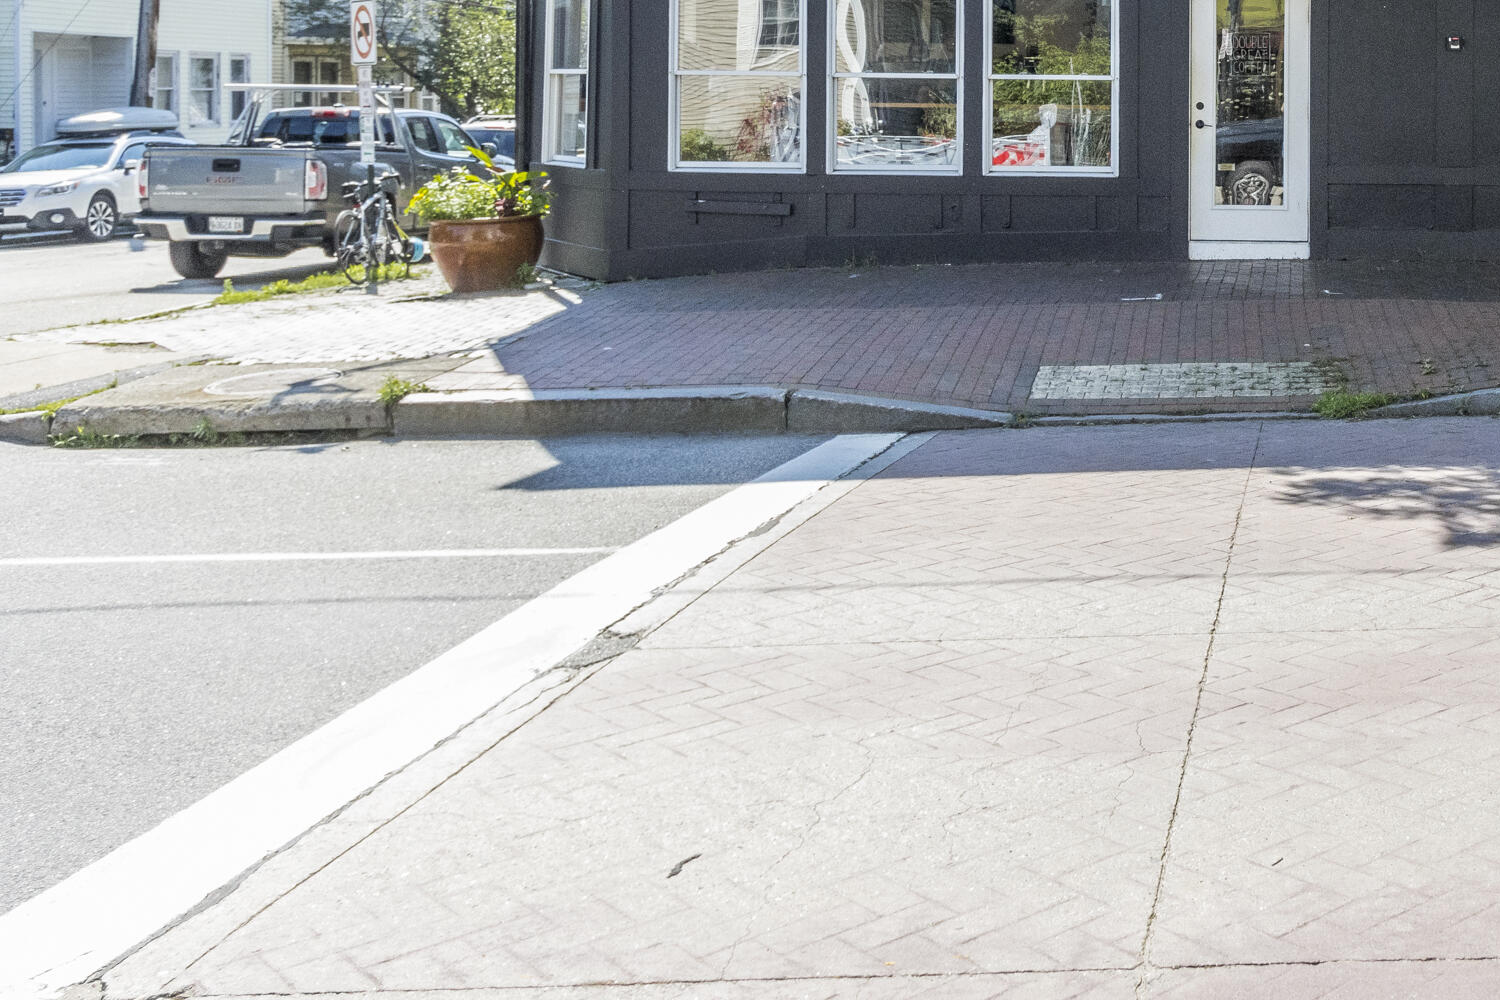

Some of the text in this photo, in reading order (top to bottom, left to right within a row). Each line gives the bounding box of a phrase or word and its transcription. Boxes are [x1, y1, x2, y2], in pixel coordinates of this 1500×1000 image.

[1232, 35, 1269, 49] DOUBLE
[1232, 49, 1268, 61] GREAT
[1232, 61, 1269, 74] COFFEE
